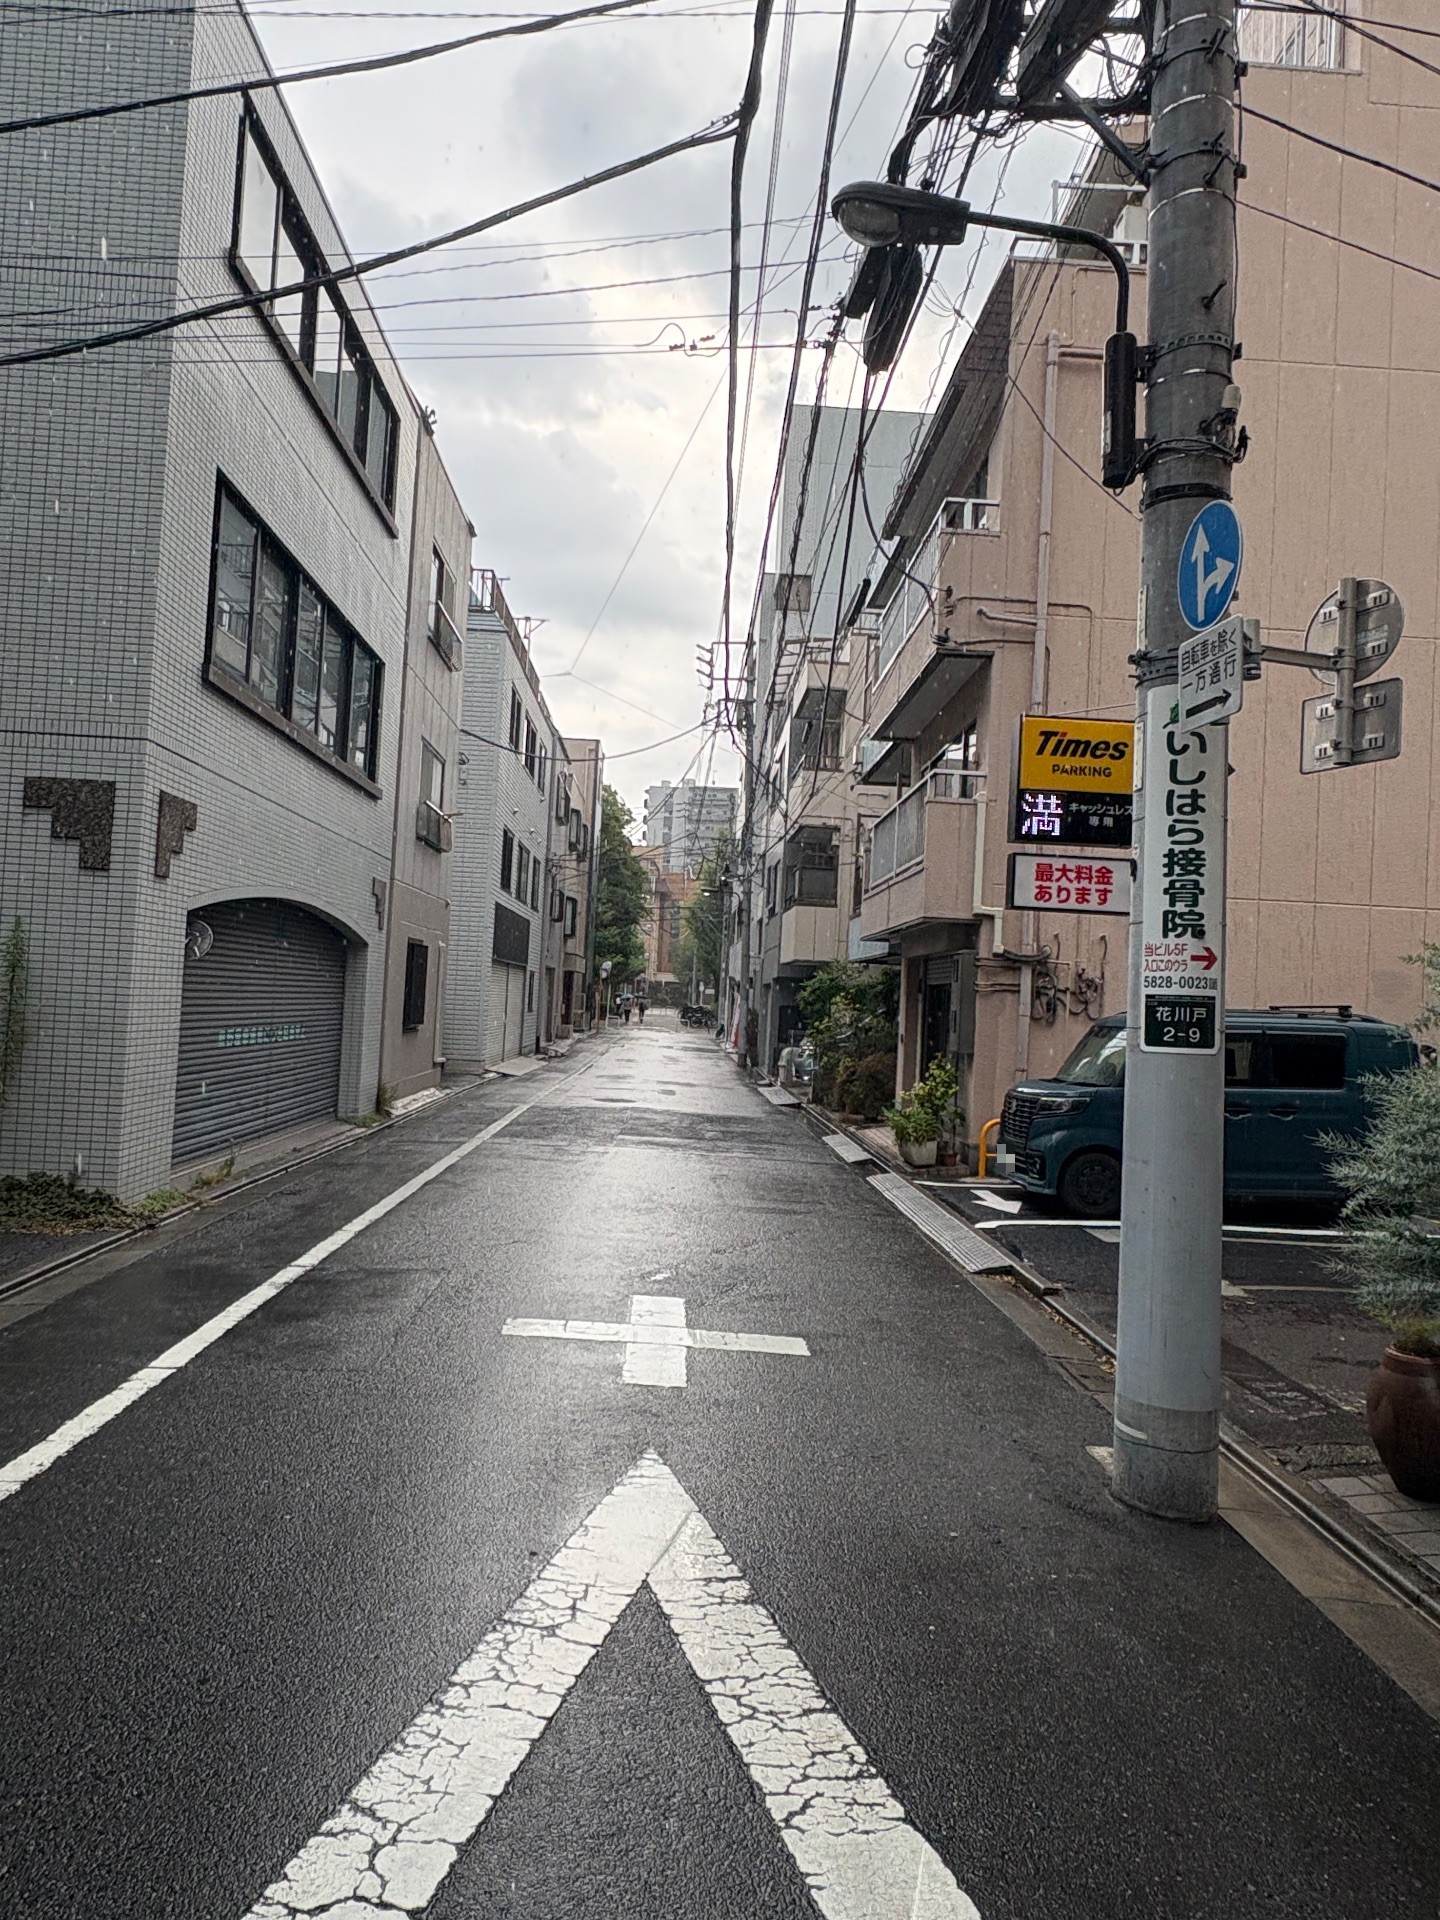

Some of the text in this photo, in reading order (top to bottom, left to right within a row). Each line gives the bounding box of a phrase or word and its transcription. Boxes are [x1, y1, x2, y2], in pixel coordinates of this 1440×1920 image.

[1181, 628, 1237, 672] 自転車を除く
[1181, 654, 1236, 693] 一方通行
[1036, 730, 1129, 761] Times
[1051, 764, 1112, 778] PARKING
[1022, 793, 1063, 836] 満
[1069, 802, 1133, 816] キャッシュレス
[1162, 730, 1207, 939] いしはら接骨院
[1034, 863, 1114, 886] 最大料金
[1034, 884, 1113, 906] あります
[1144, 942, 1188, 957] 当ビル5F
[1143, 959, 1188, 973] 入口このウラ
[1143, 975, 1208, 990] 5828-0023
[1155, 1006, 1208, 1023] 花川戸
[1163, 1026, 1201, 1043] 2-9
